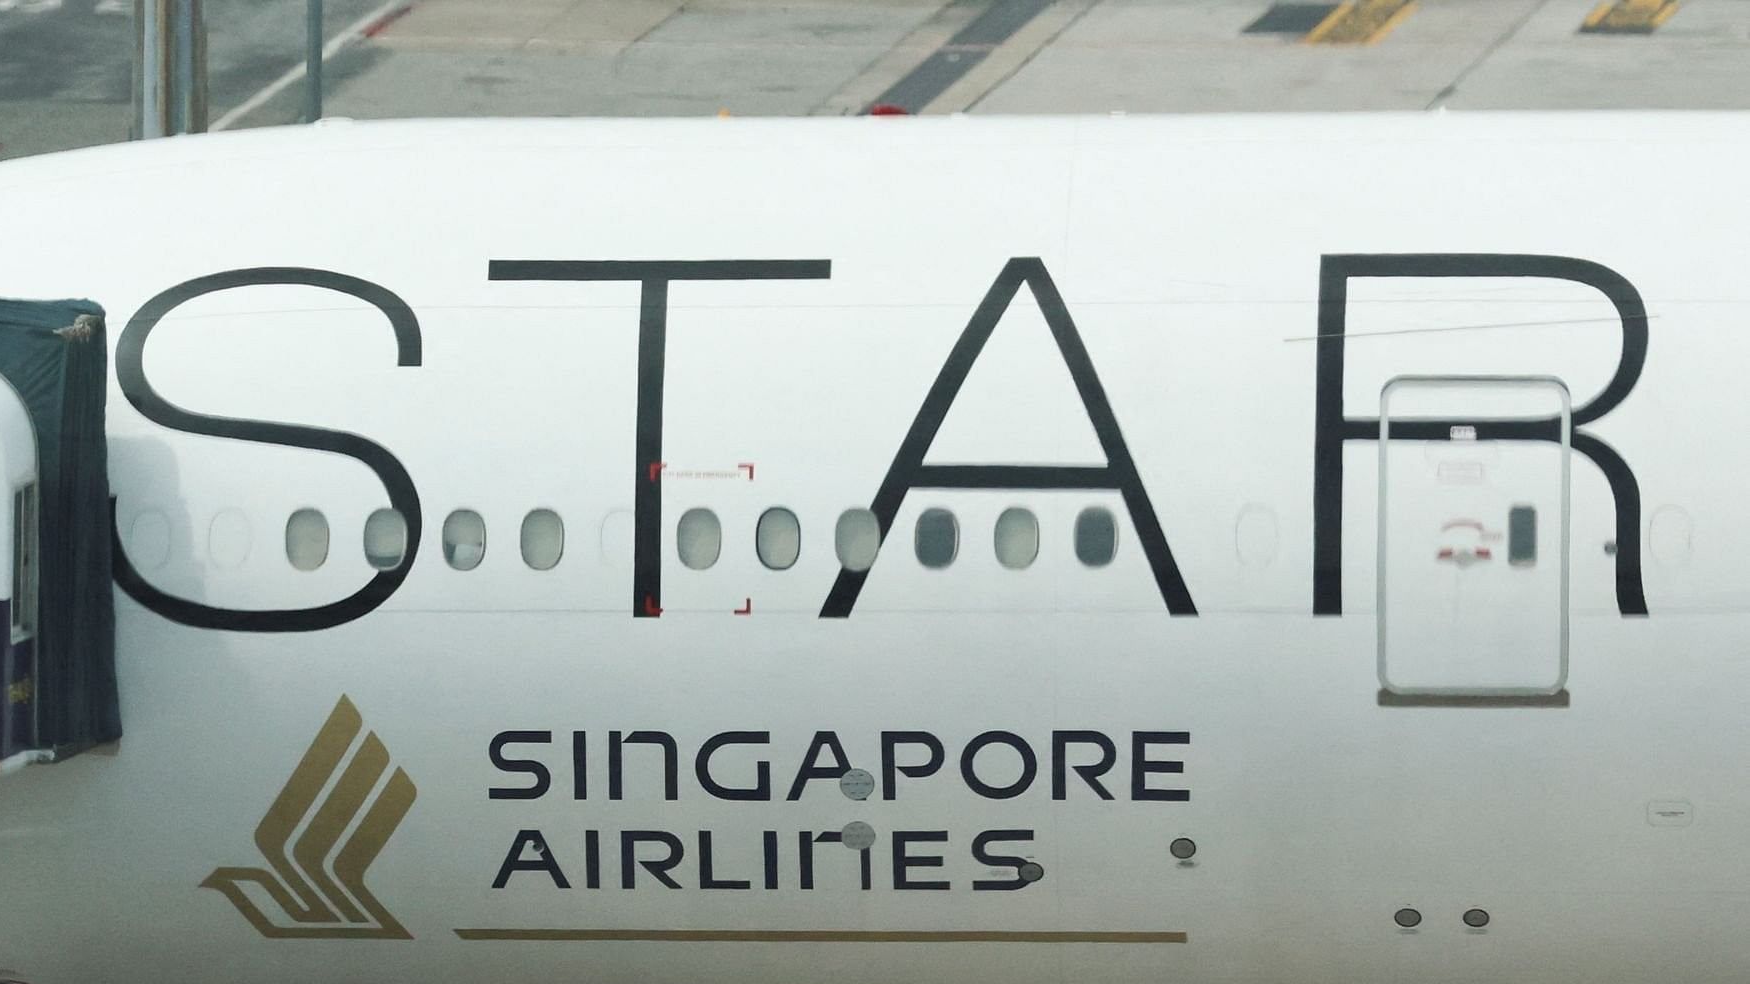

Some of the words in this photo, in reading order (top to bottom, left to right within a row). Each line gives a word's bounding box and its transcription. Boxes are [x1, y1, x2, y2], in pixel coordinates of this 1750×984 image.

[111, 253, 1649, 632] STAR
[488, 731, 1190, 801] SINGAPORE
[491, 830, 1044, 890] AIRLINES
